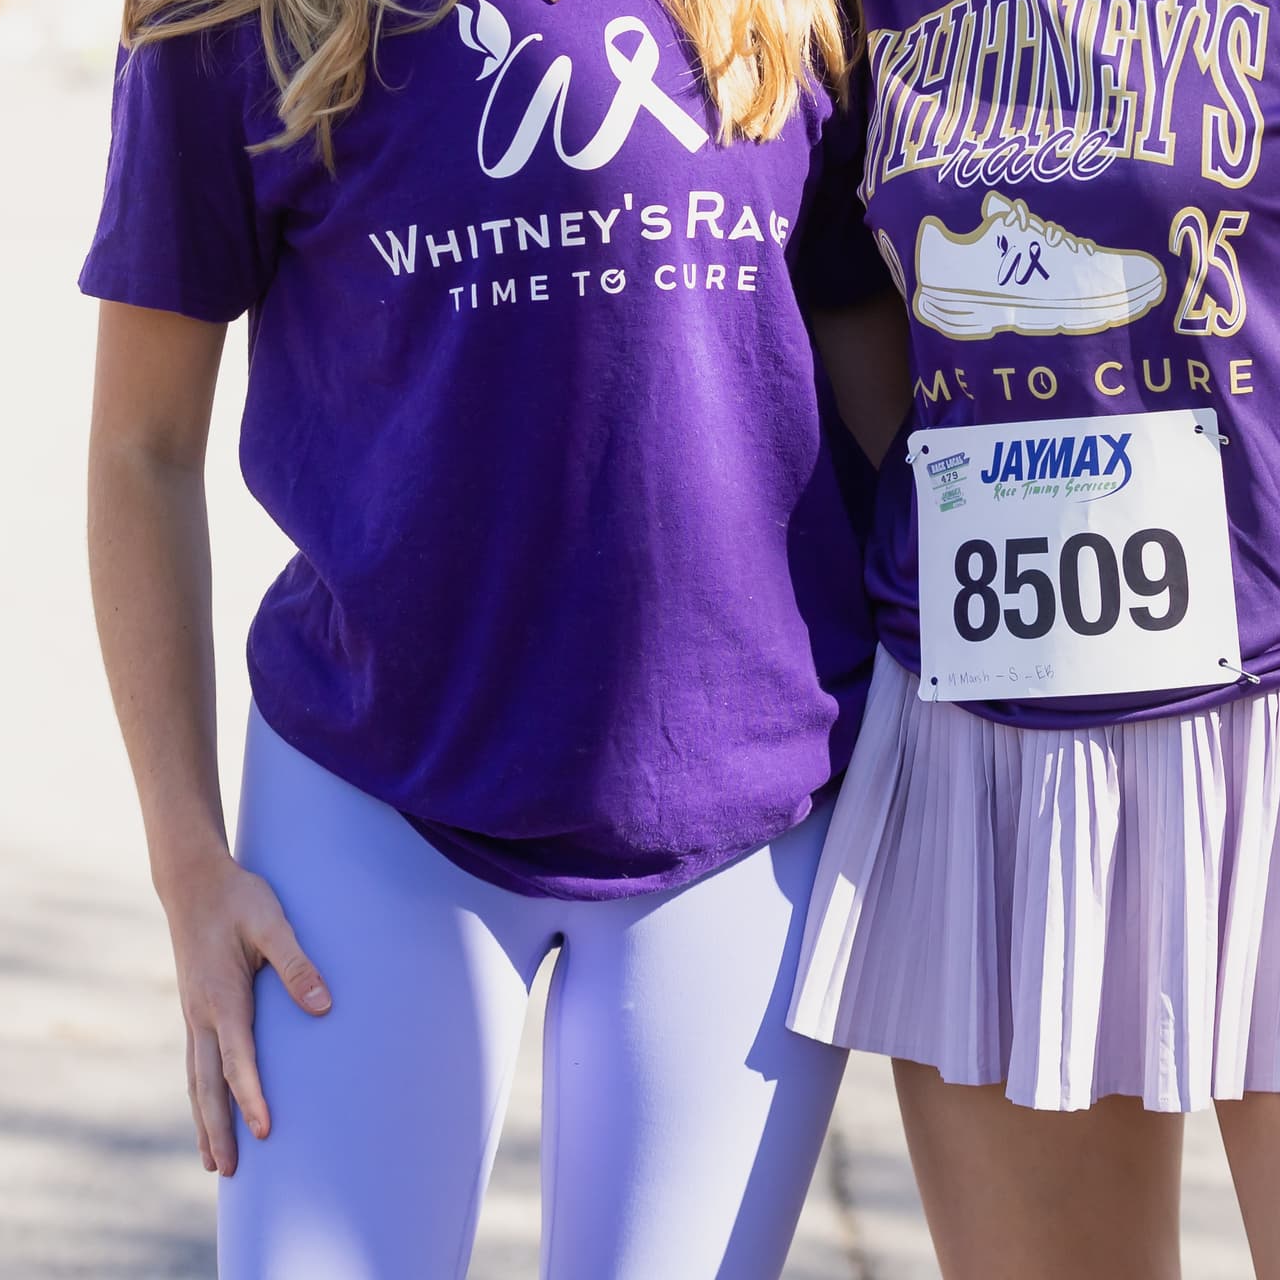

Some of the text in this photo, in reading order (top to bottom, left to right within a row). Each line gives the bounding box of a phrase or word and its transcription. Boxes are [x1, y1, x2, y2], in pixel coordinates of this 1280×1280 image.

[938, 127, 1116, 188] race
[449, 263, 759, 313] TIME TO CURE
[993, 366, 1058, 401] TO
[1094, 357, 1254, 397] CURE
[940, 471, 960, 484] 479
[980, 433, 1133, 487] JAYMAX
[993, 478, 1119, 501] Race Timing Services
[952, 528, 1191, 642] 8509
